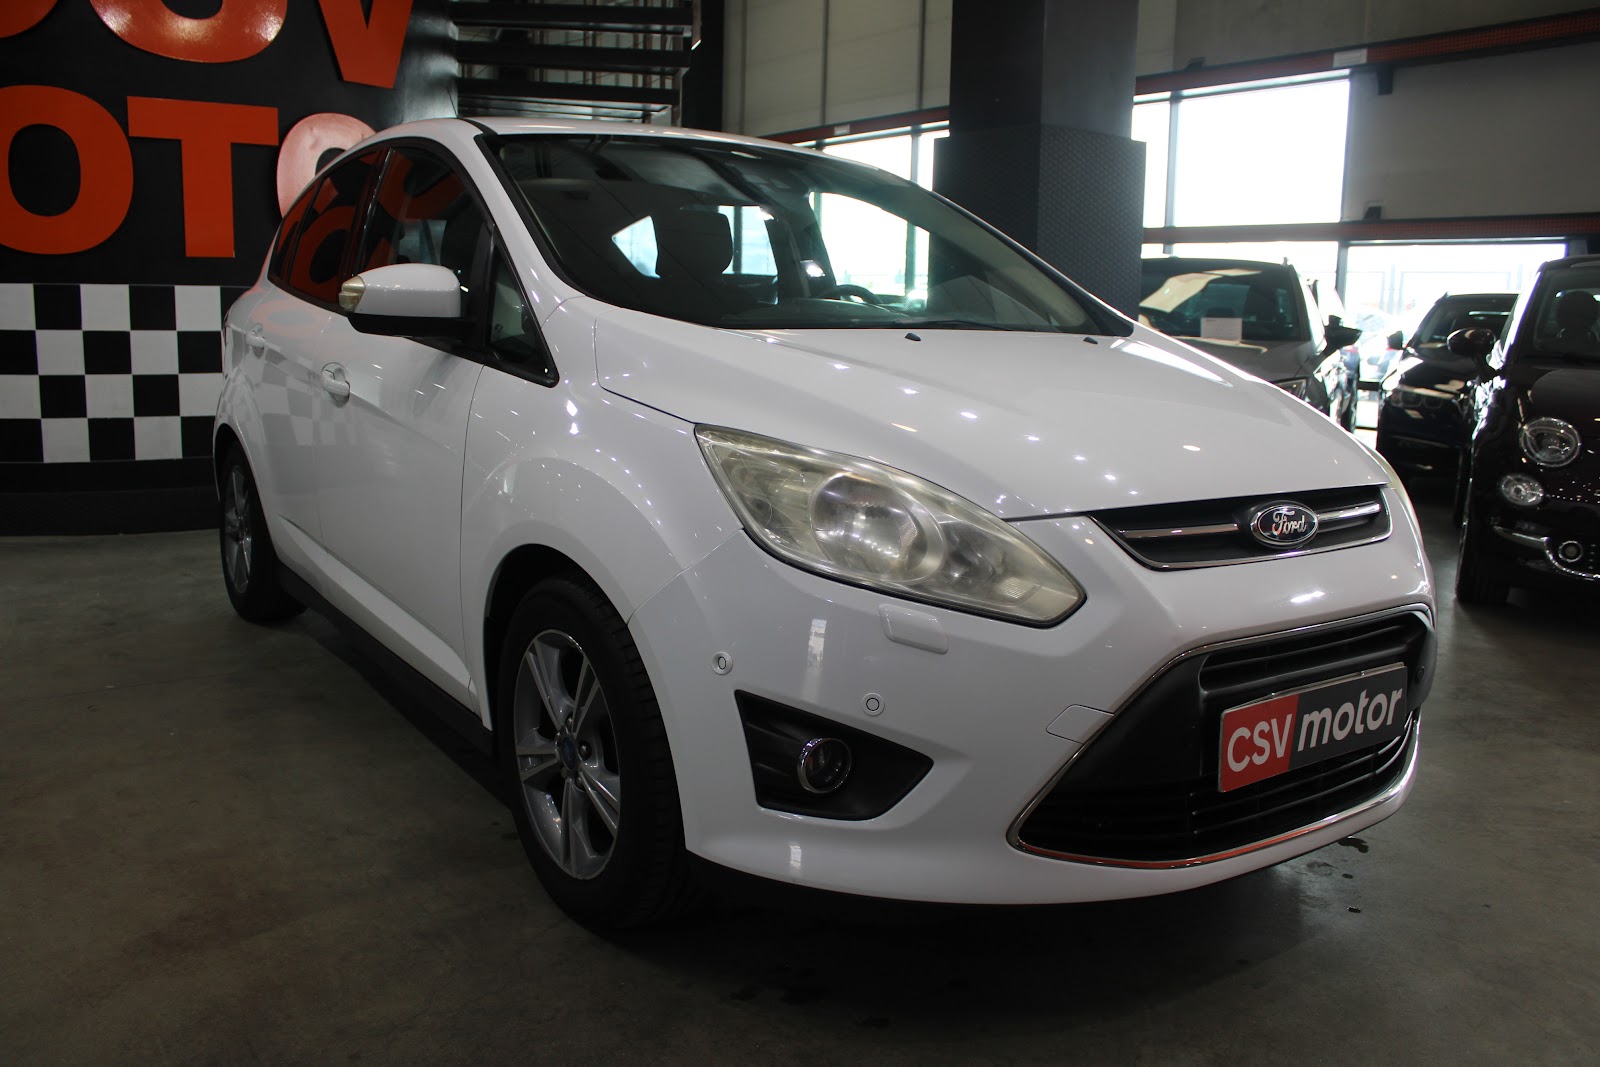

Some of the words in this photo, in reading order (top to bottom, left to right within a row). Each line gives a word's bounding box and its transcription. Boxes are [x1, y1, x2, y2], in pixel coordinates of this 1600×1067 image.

[1271, 510, 1308, 536] Ford
[1227, 713, 1293, 773] CSV
[1297, 688, 1403, 752] motor
